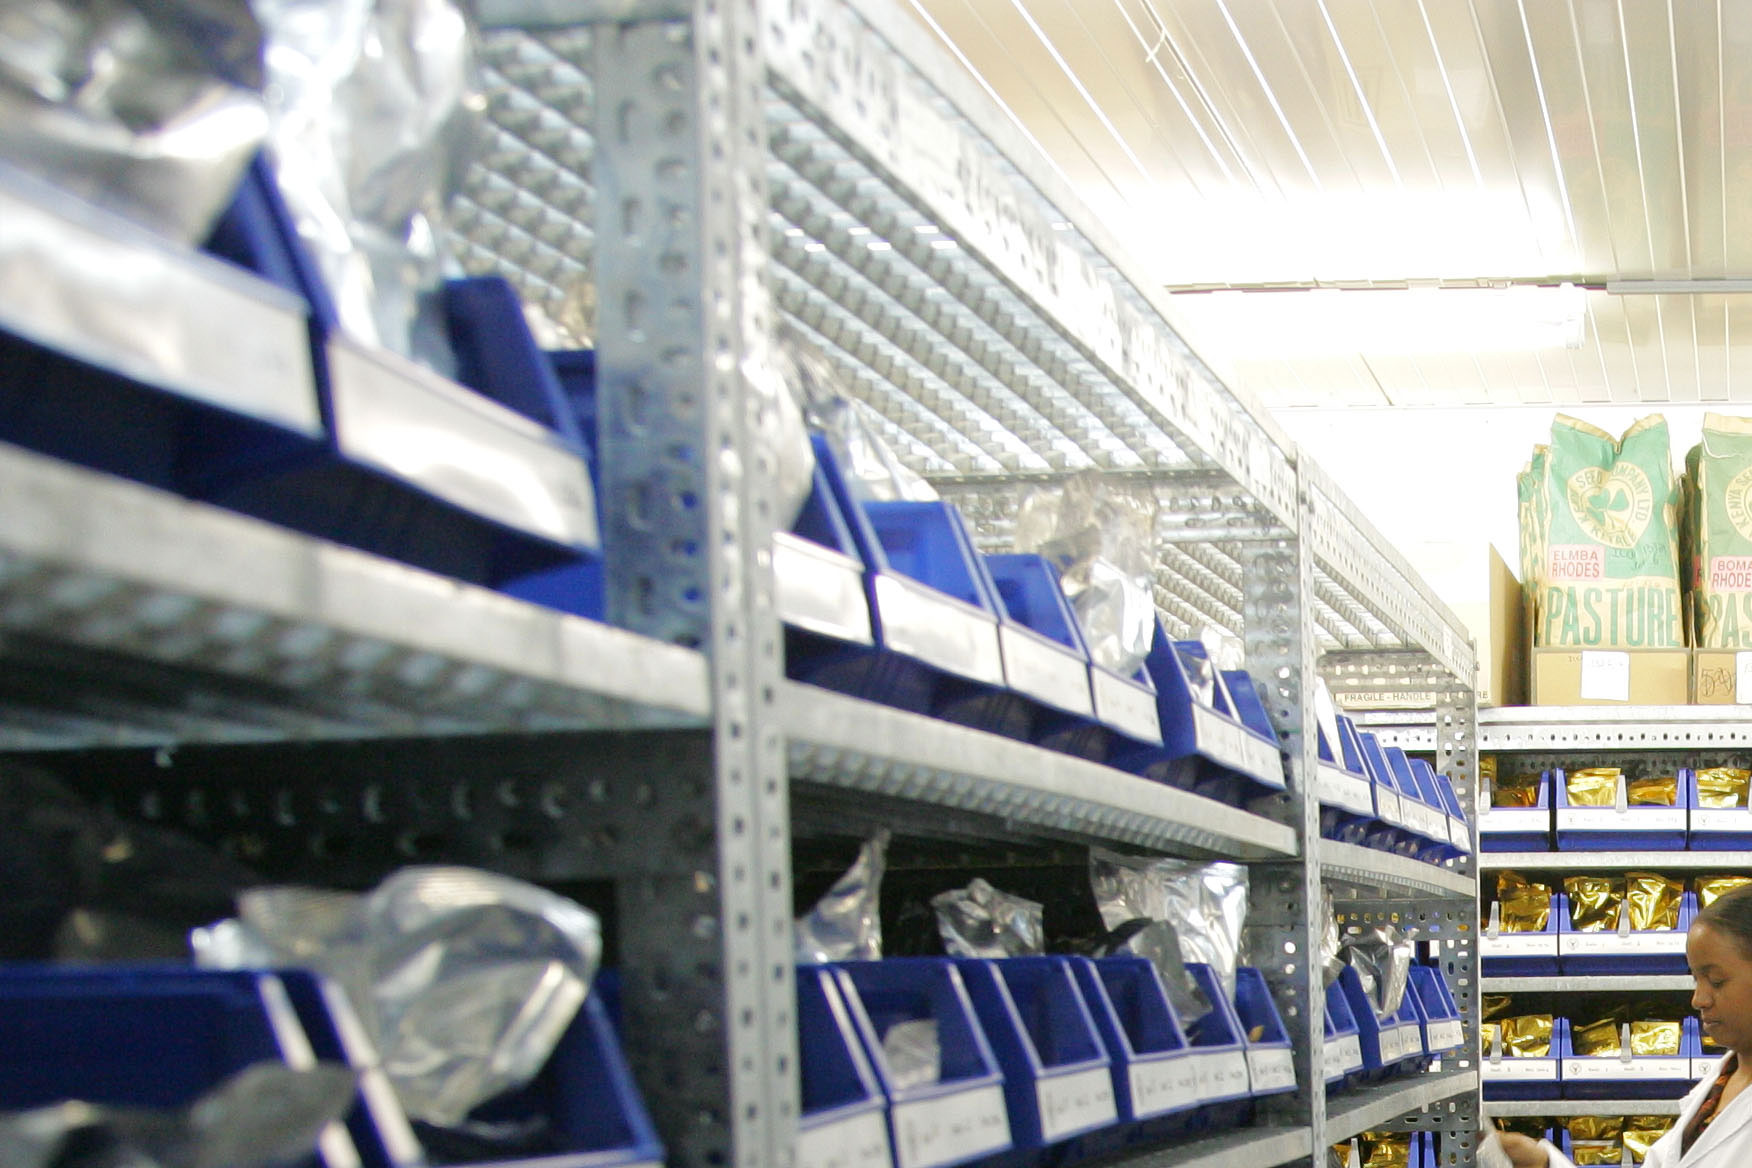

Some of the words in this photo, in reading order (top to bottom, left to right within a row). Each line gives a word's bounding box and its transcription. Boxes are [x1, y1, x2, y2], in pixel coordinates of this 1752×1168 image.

[1728, 488, 1748, 527] KENYA
[1553, 550, 1599, 561] ELMBA
[1552, 562, 1600, 578] RHODES
[1545, 586, 1681, 648] PASTURE
[1344, 692, 1385, 702] FRAGILE
[1393, 691, 1431, 701] HANDLE
